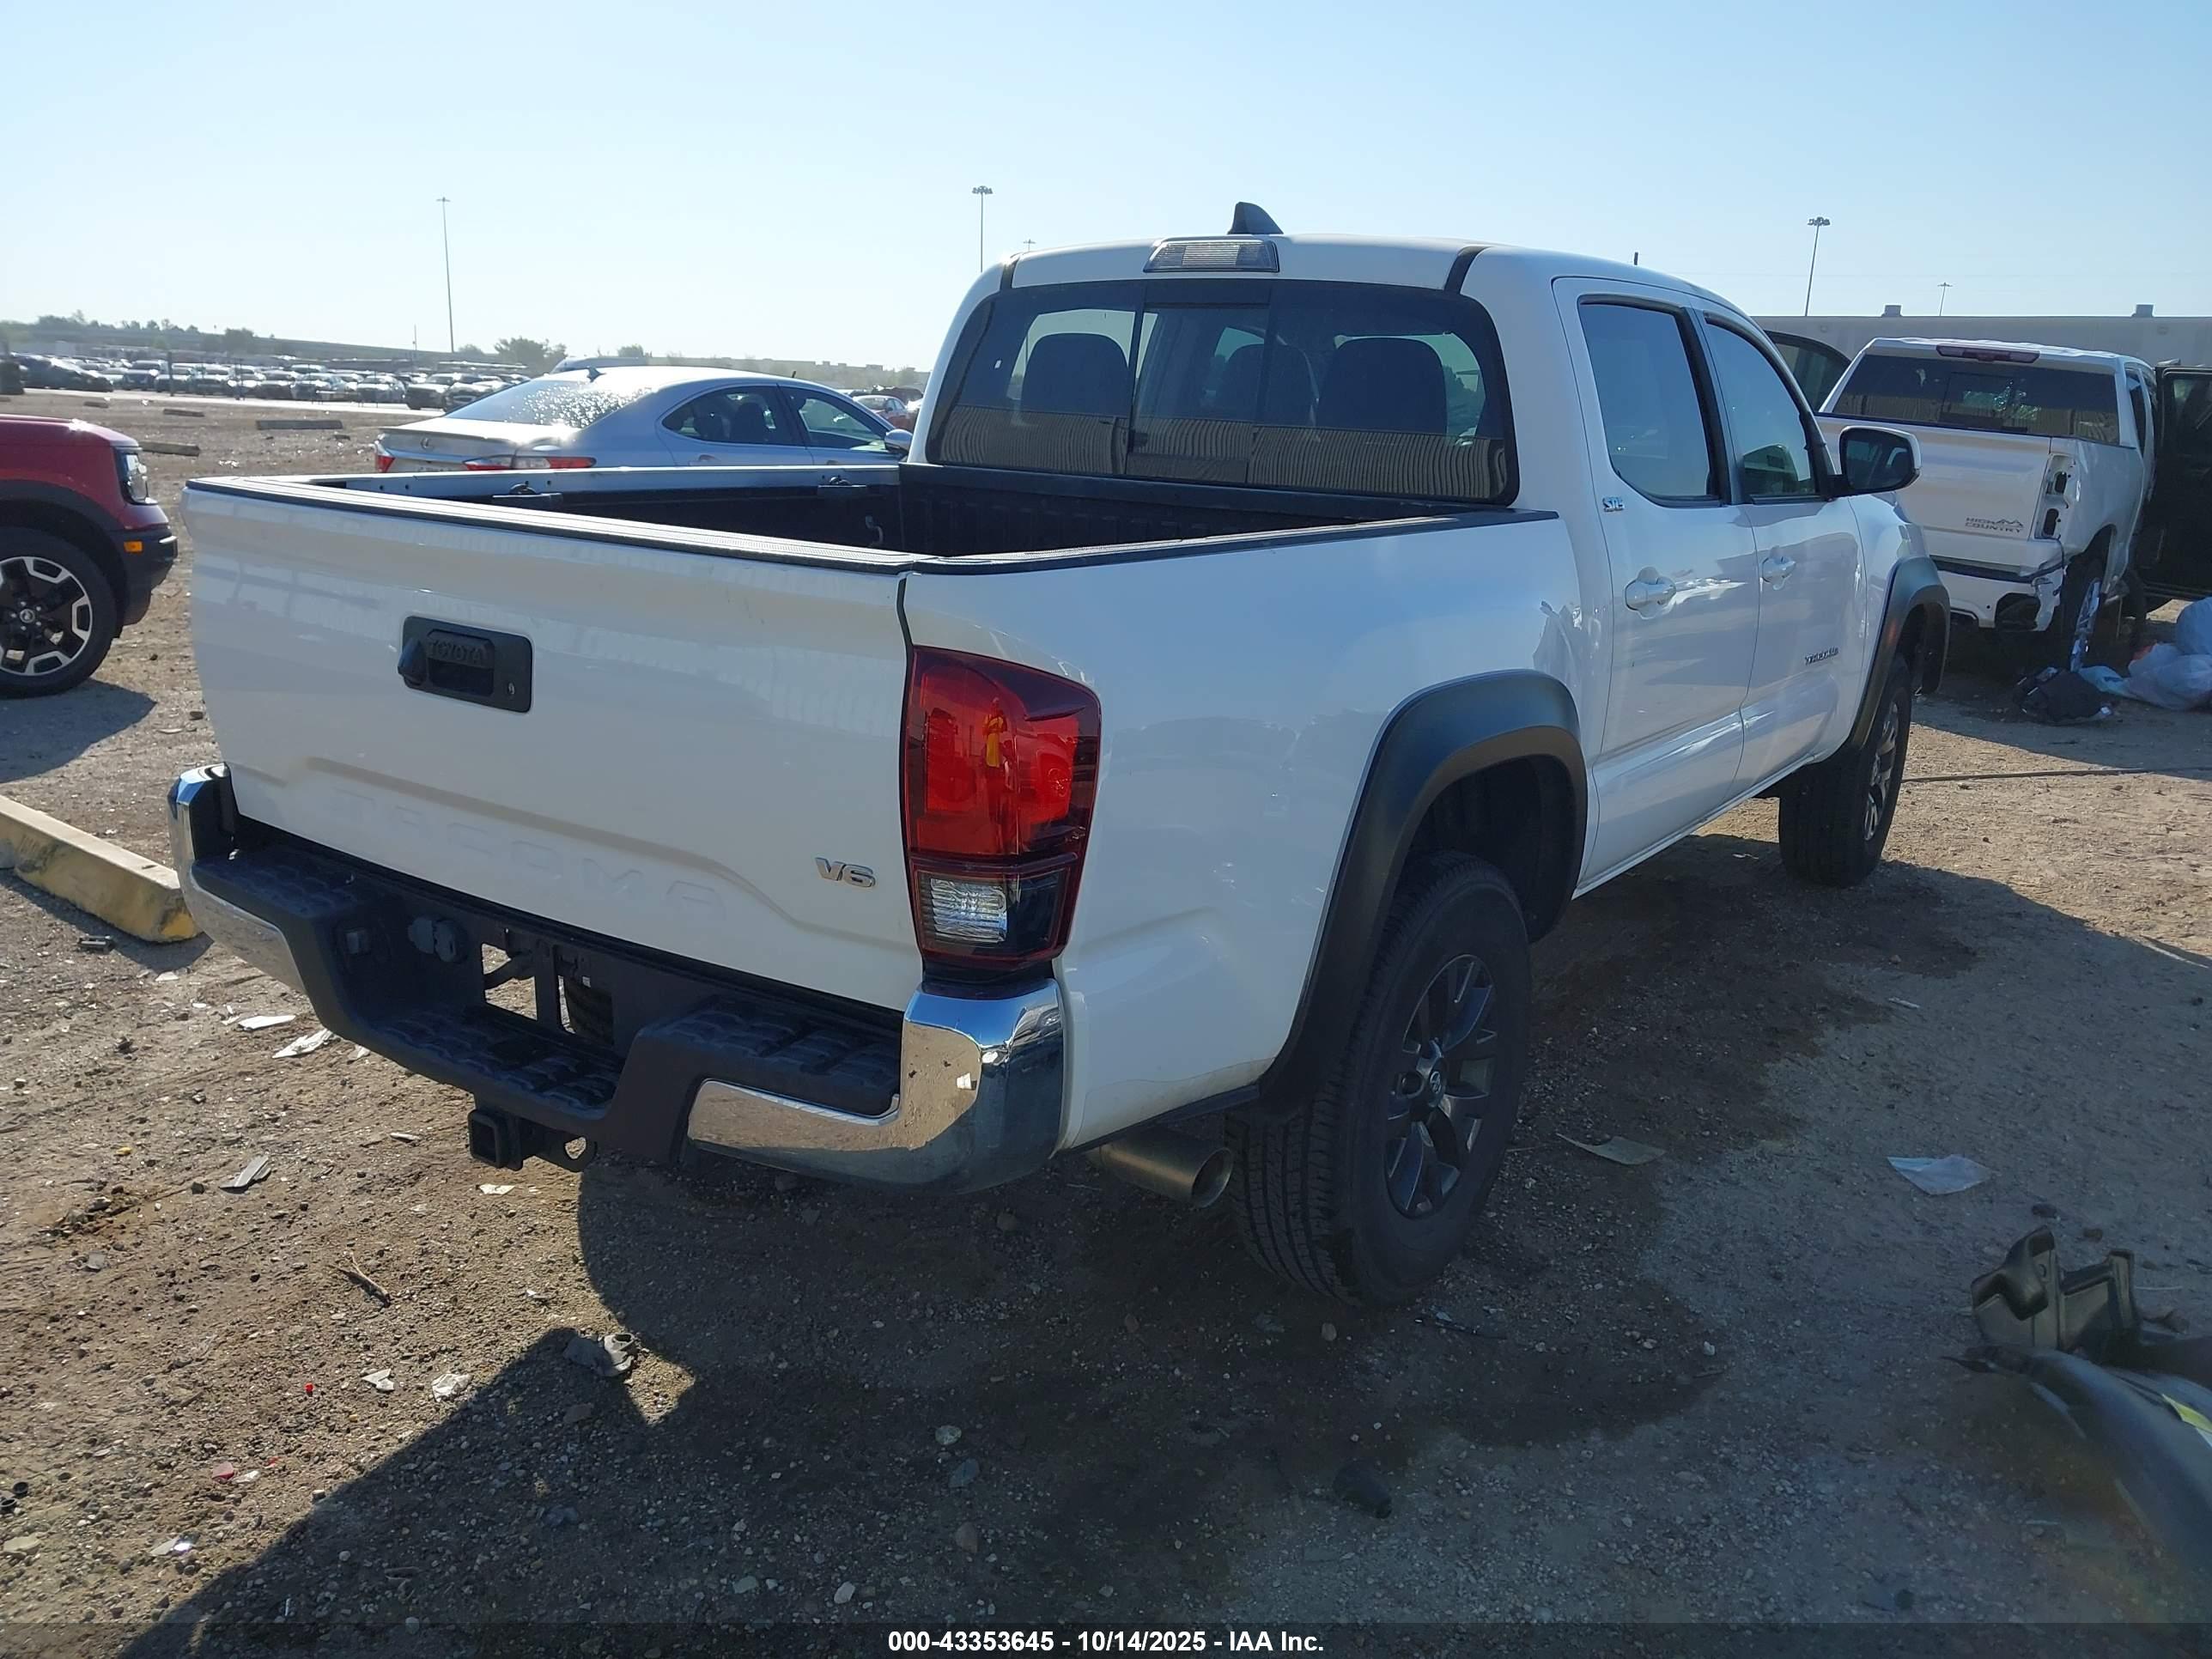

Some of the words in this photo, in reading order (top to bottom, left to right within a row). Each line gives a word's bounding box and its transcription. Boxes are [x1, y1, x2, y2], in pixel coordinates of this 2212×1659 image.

[1965, 522, 2021, 533] COUNTRY
[427, 640, 482, 664] TOYOTA
[325, 787, 726, 921] TACOMA
[814, 856, 877, 888] V6
